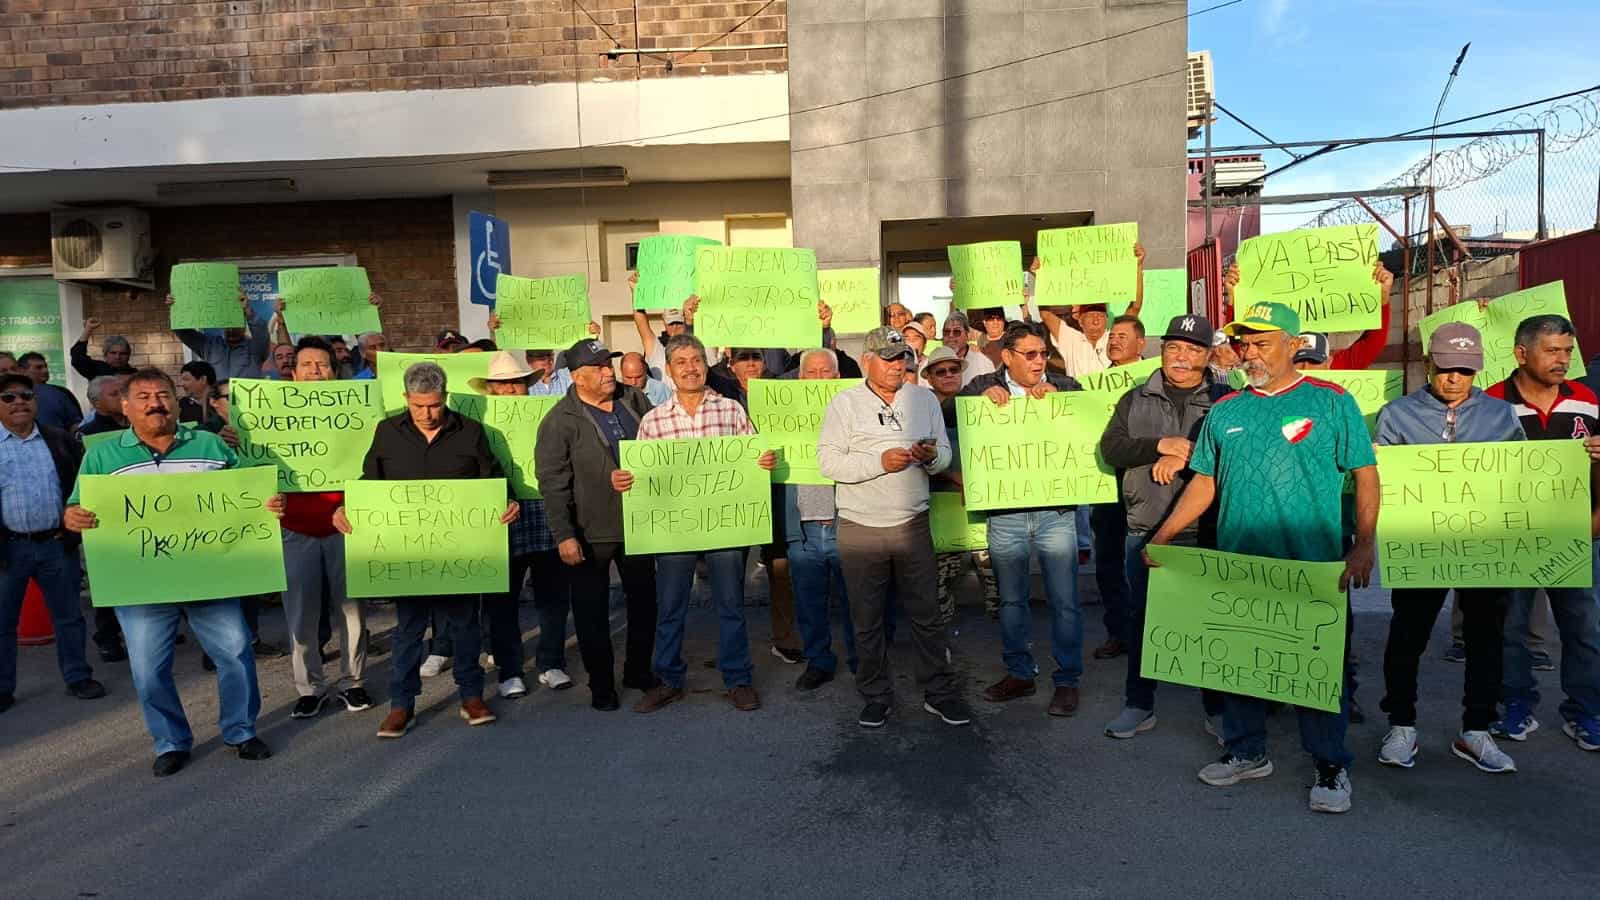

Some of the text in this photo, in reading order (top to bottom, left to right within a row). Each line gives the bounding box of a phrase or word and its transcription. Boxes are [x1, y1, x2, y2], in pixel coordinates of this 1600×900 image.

[698, 249, 815, 275] QUEREMOS
[1272, 265, 1339, 295] DE
[701, 283, 812, 310] NUESTROS
[700, 312, 777, 336] PAGOS
[766, 384, 793, 406] NO
[1088, 370, 1137, 392] VIDA
[231, 382, 371, 410] ¡YA BASTA!
[237, 412, 365, 432] QUEREMOS
[494, 399, 553, 424] BAST
[964, 395, 1077, 426] BASTA DE
[234, 438, 329, 459] NUESTRO
[624, 436, 761, 469] CONFIAMOS
[969, 440, 1098, 471] MENTIRAS
[1413, 447, 1563, 476] SEGUIMOS
[278, 468, 345, 487] AGO...
[669, 469, 744, 497] USTED
[1041, 475, 1111, 504] VENTA
[1380, 476, 1590, 506] EN LA LUCHA
[124, 490, 262, 523] NO MAS
[389, 484, 454, 506] CERO
[351, 507, 501, 529] TOLERANCIA
[631, 501, 771, 536] PRESIDENTA
[1431, 510, 1544, 534] POR EL
[373, 531, 457, 553] A MAS
[1386, 536, 1558, 560] BIENESTAR
[367, 557, 499, 585] RETRASOS
[1186, 552, 1314, 596] JUSTICIA
[1387, 538, 1590, 585] DE NUESTRA FAMILIA
[1149, 624, 1329, 681] COMO DIJO
[1153, 652, 1342, 706] LA PRESIDENTA
